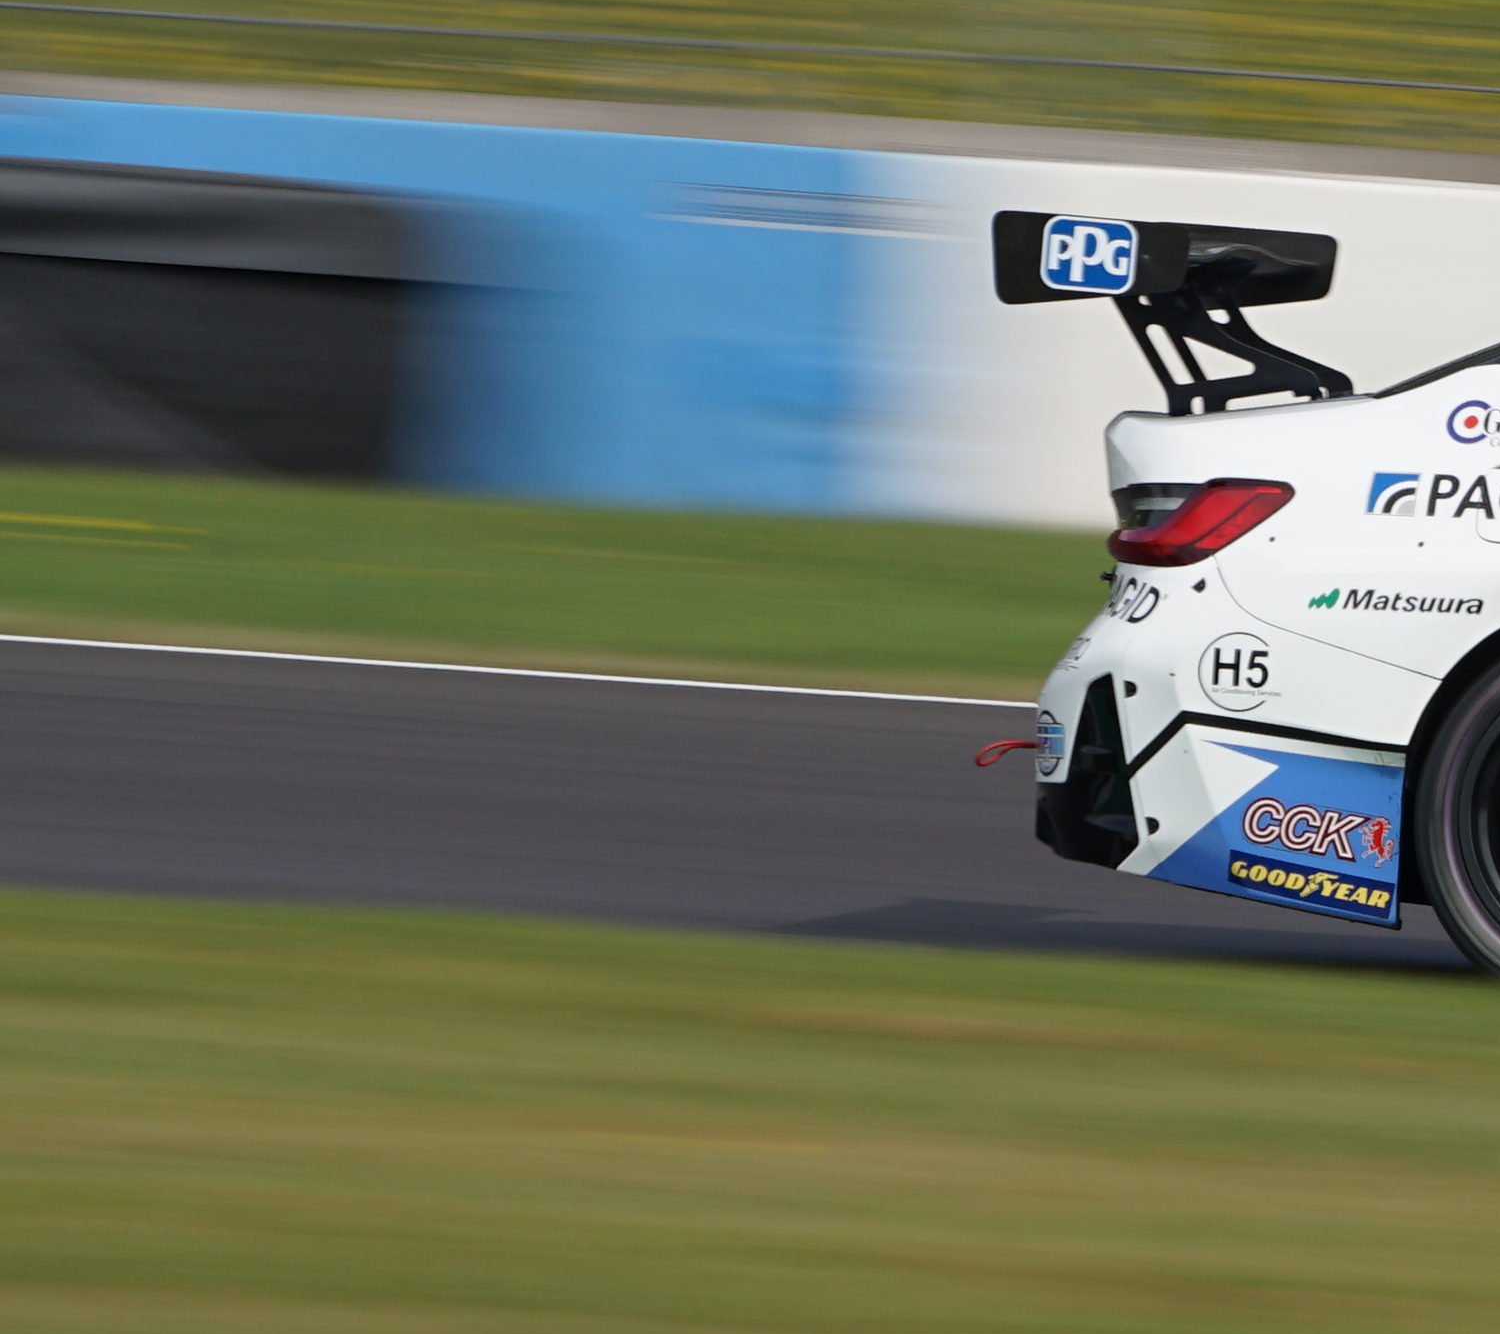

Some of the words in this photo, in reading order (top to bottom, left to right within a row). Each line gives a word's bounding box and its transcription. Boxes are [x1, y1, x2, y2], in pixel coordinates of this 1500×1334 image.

[1048, 225, 1130, 282] PPG
[1342, 587, 1484, 616] Matsuura
[1212, 647, 1269, 688] H5
[1243, 797, 1372, 862] CCK
[1230, 860, 1391, 908] GOODYEAR
